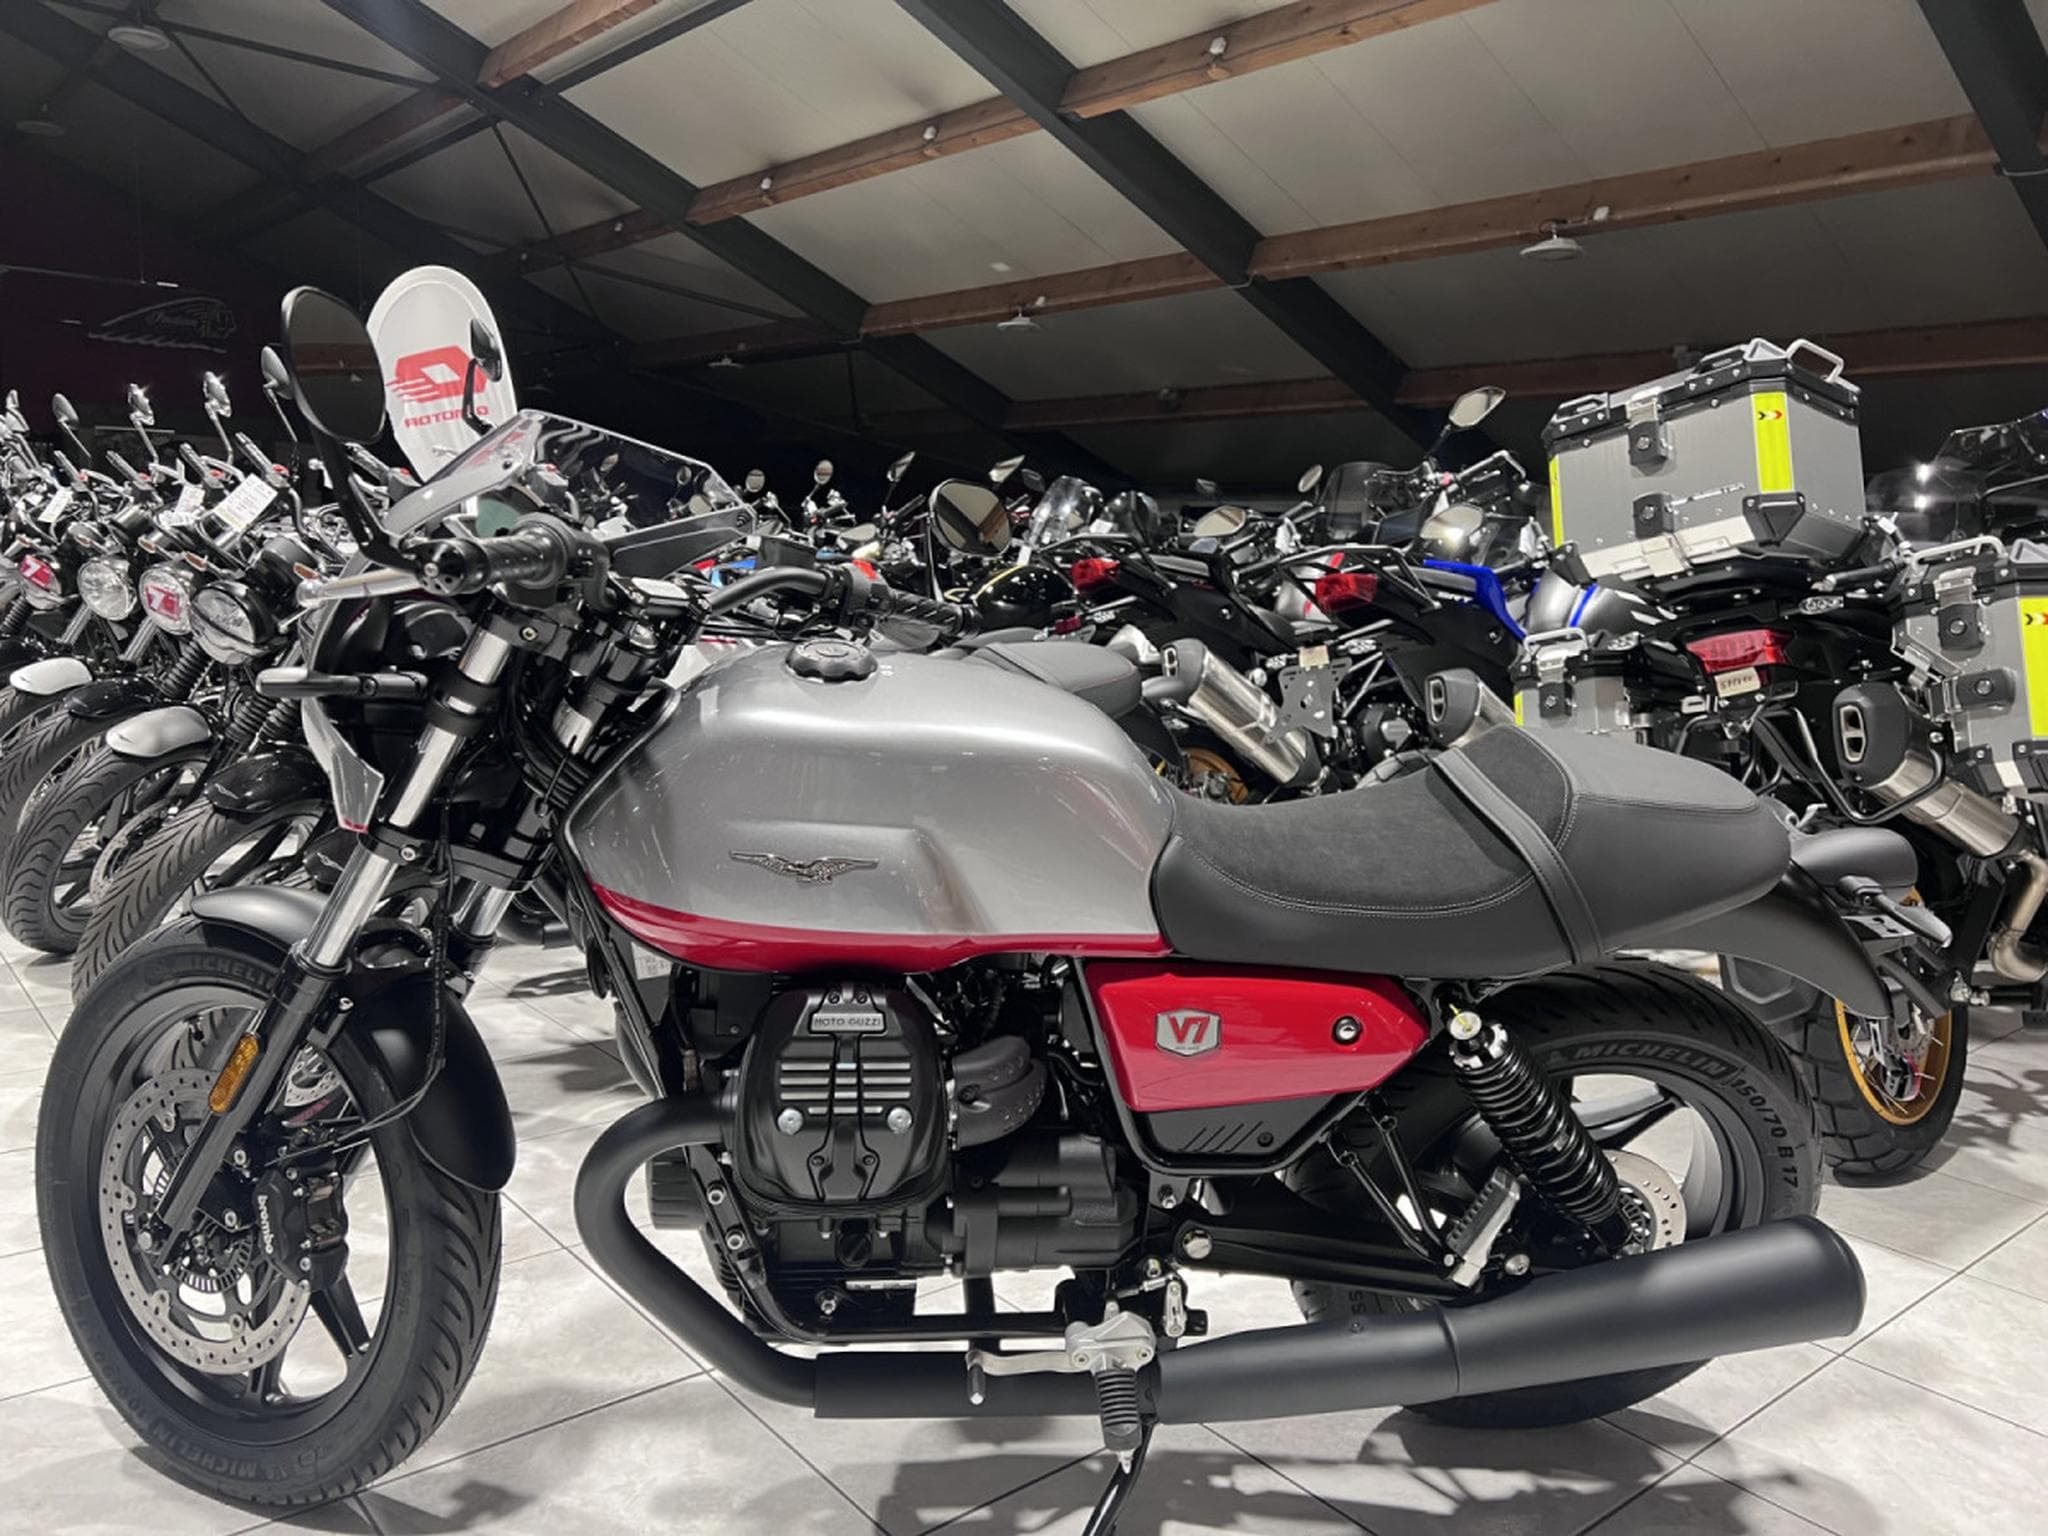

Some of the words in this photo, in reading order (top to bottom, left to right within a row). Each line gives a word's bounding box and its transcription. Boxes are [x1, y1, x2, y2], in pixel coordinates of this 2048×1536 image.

[1167, 1015, 1211, 1044] V7
[1574, 1043, 1729, 1078] MICHELIN
[1731, 1079, 1788, 1140] 150/70
[1782, 1165, 1799, 1189] 17
[257, 1195, 275, 1254] brembo
